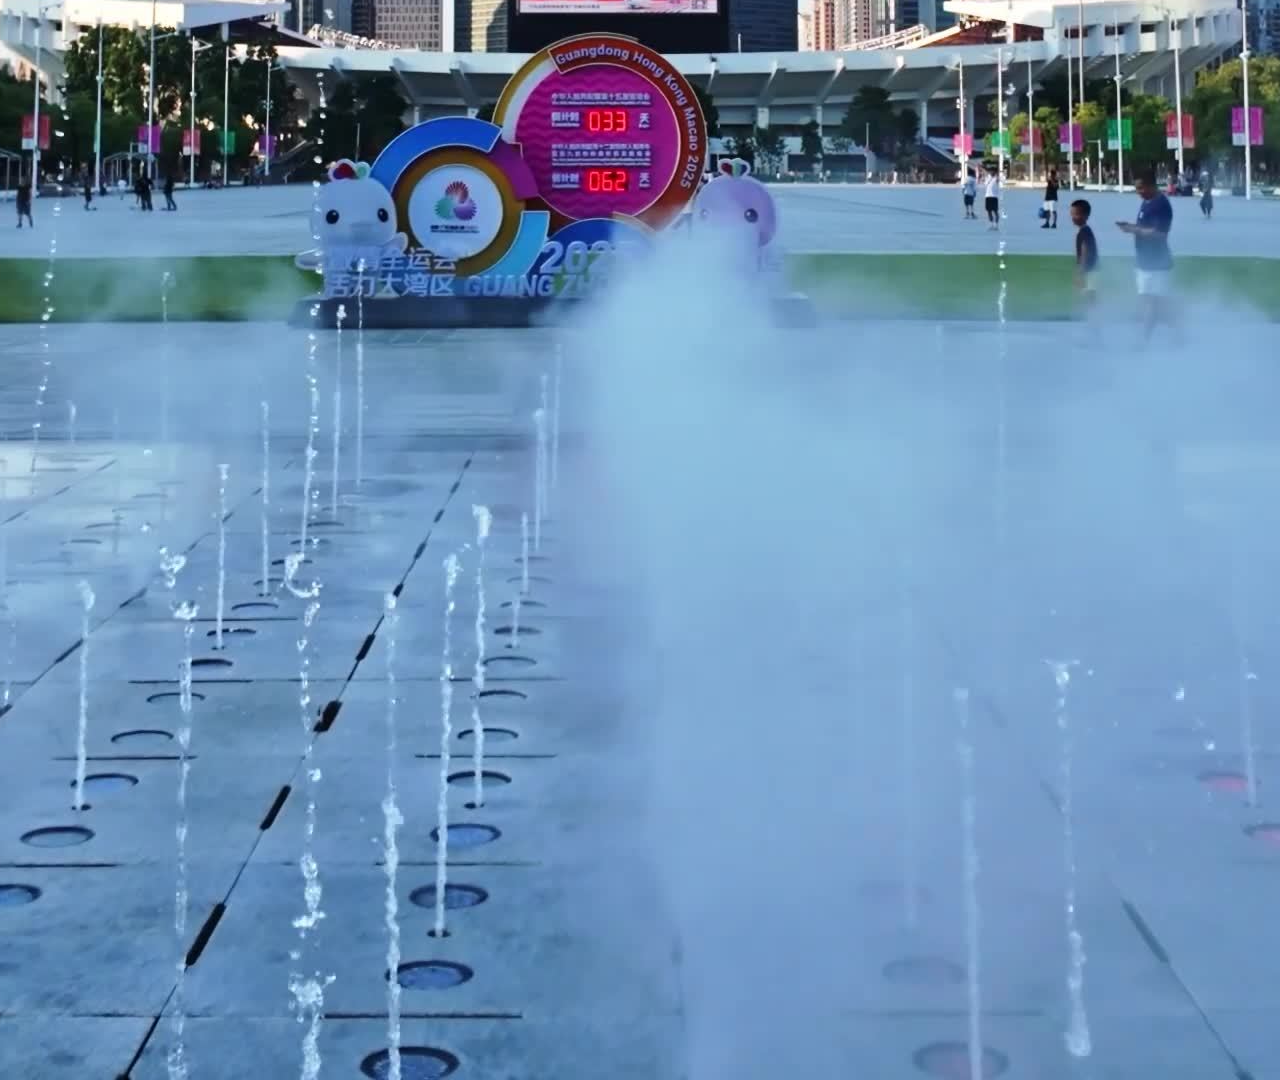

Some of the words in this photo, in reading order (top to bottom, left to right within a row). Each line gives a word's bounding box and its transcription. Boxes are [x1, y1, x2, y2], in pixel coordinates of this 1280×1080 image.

[555, 44, 629, 65] Guangdong
[633, 51, 664, 79] Hong
[664, 74, 688, 106] Kong
[589, 111, 626, 131] 033
[684, 106, 698, 151] Macao
[589, 171, 626, 191] 062
[680, 155, 699, 189] 2025
[540, 240, 634, 273] 202
[464, 274, 554, 296] GUANG
